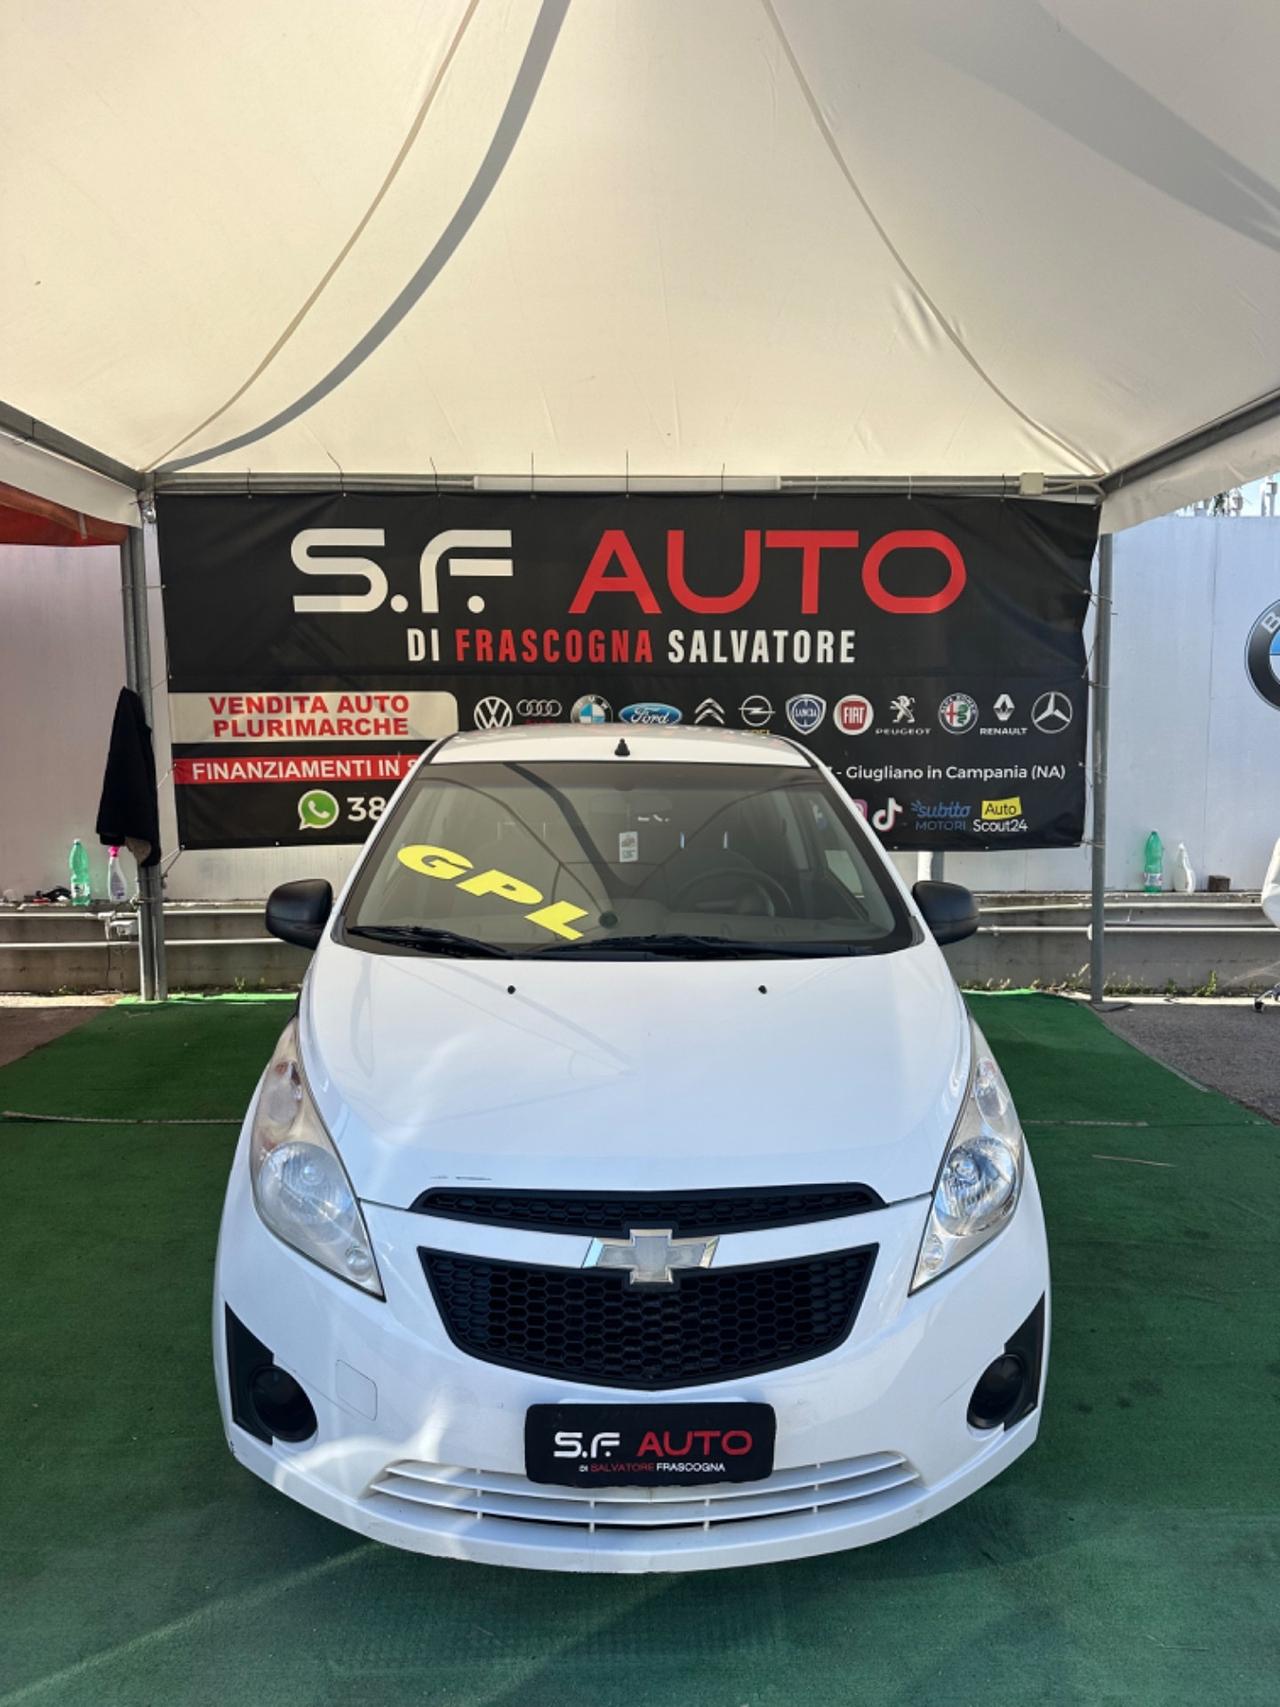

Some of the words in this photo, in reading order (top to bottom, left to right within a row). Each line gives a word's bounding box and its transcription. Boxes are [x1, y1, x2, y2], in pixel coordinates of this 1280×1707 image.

[291, 528, 514, 614] S.F.
[568, 529, 967, 615] AUTO
[407, 628, 440, 662] DI
[455, 629, 653, 663] FRASCOGNA
[668, 629, 856, 663] SALVATORE
[208, 696, 328, 715] VENDITA
[338, 695, 410, 714] AUTO
[629, 706, 670, 724] Ford
[843, 706, 866, 724] FIAT
[213, 717, 409, 738] PLURIMARCHE
[875, 727, 932, 736] PEUGEOT
[979, 727, 1029, 736] RENAULT
[192, 760, 372, 780] FINANZIAMENTI
[378, 759, 401, 777] IN
[845, 765, 923, 781] Giugliano
[927, 764, 942, 779] in
[946, 765, 1028, 781] Campania
[1031, 765, 1067, 780] (NA)
[917, 800, 972, 818] subito
[984, 802, 1018, 816] Auto
[915, 821, 966, 831] MOTORI
[972, 818, 1028, 833] Scout24
[397, 844, 589, 941] GPL
[553, 1431, 620, 1459] S.F.
[636, 1430, 753, 1457] AUTO
[590, 1462, 654, 1473] SALVATORE
[656, 1462, 726, 1473] FRASCOGNA
